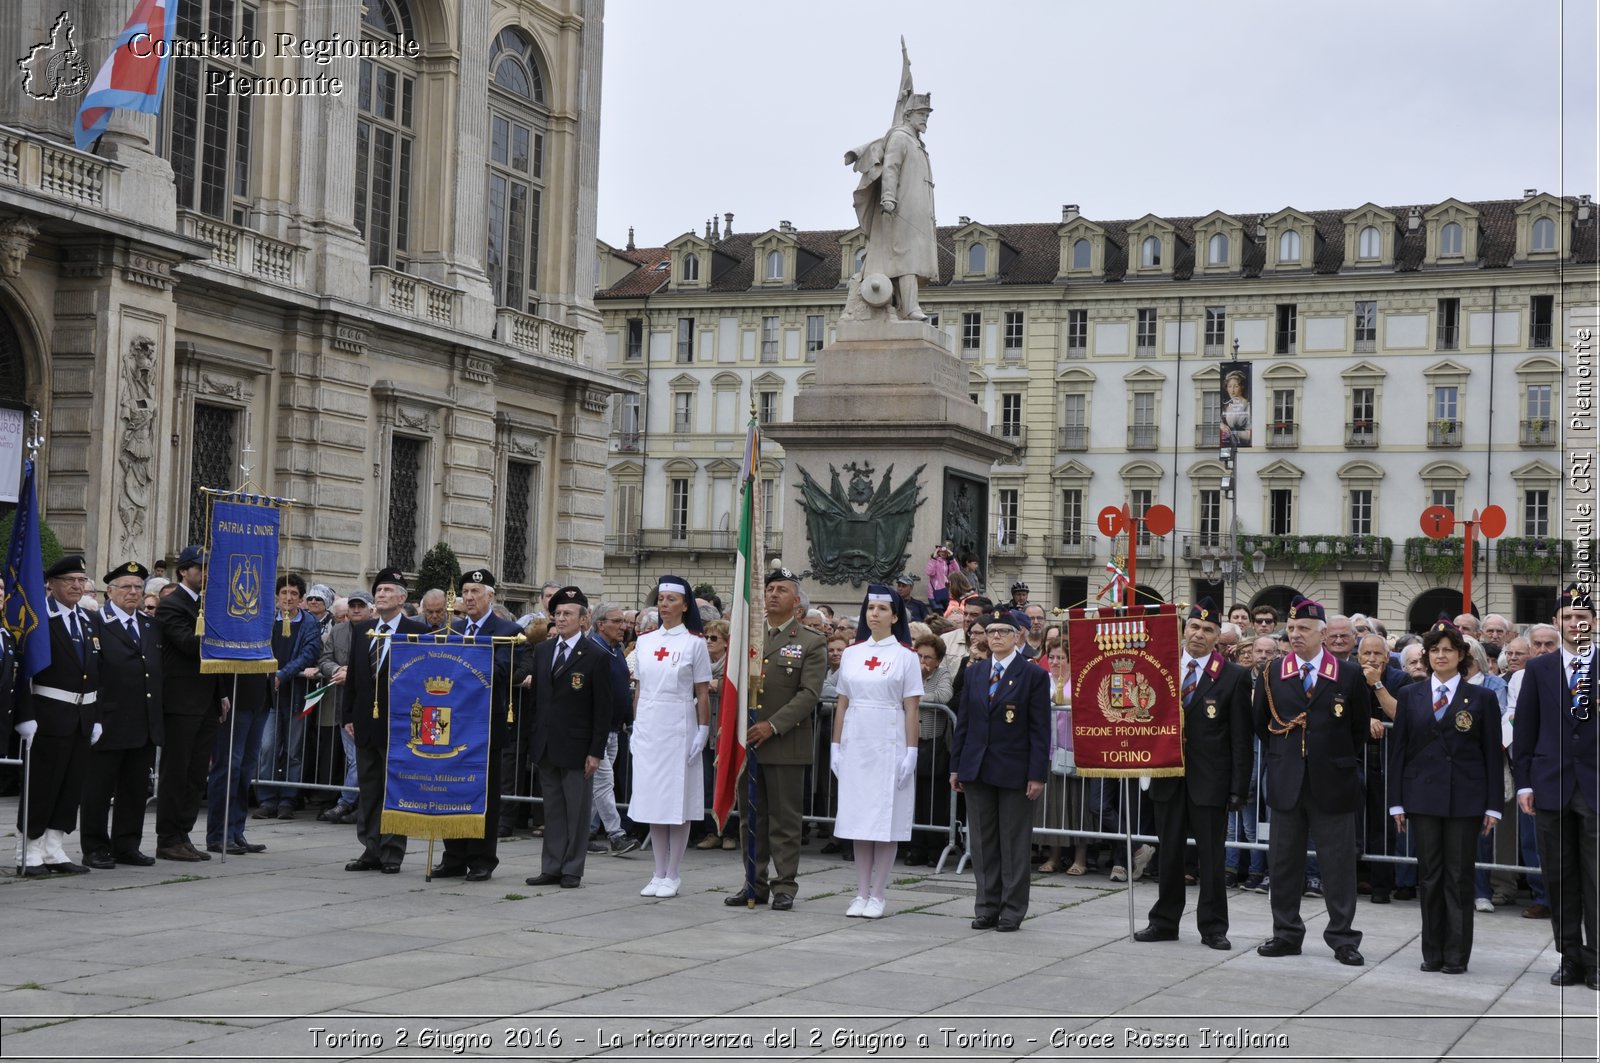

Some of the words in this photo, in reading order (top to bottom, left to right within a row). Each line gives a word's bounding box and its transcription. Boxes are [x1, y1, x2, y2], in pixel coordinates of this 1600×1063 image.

[218, 521, 244, 534] PATRIA
[247, 524, 252, 534] E
[254, 525, 274, 536] ONORE
[1104, 513, 1116, 532] T
[427, 651, 464, 664] Nazionale
[1074, 654, 1104, 698] Associazione
[1104, 648, 1139, 658] Nazionale
[1139, 650, 1161, 669] Polizia
[1160, 668, 1169, 676] di
[1166, 675, 1177, 698] Stato
[1075, 726, 1113, 737] SEZIONE
[1115, 725, 1177, 736] PROVINCIALE
[1120, 740, 1129, 748] di
[1101, 751, 1151, 762] TORINO
[434, 774, 466, 782] Militare
[467, 774, 476, 782] di
[398, 799, 428, 810] Sezione
[429, 801, 472, 811] Piemonte
